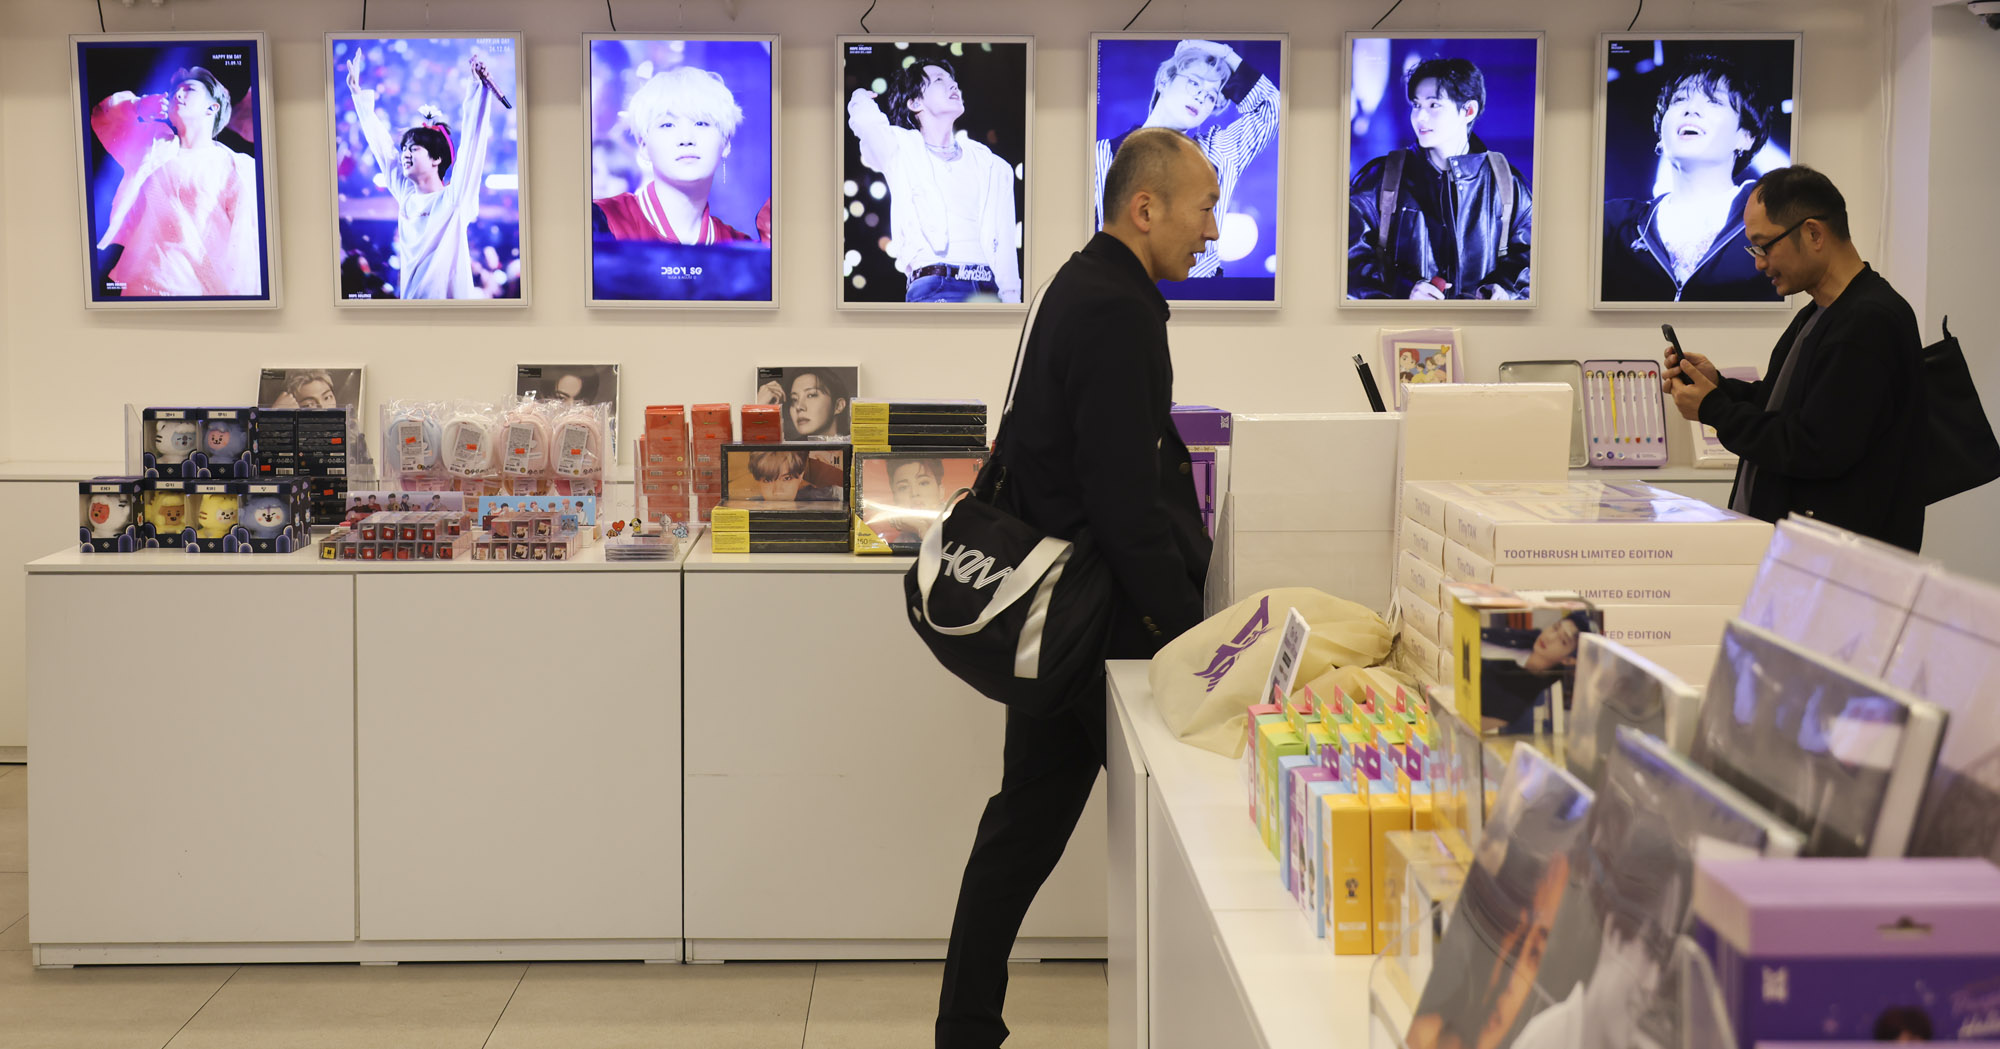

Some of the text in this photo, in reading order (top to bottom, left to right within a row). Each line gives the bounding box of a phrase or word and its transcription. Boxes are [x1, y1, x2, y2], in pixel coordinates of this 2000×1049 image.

[1504, 549, 1673, 559] TOOTHBRUSH LIMITED EDITION
[1627, 589, 1671, 599] EDITION
[1627, 630, 1671, 640] EDITION
